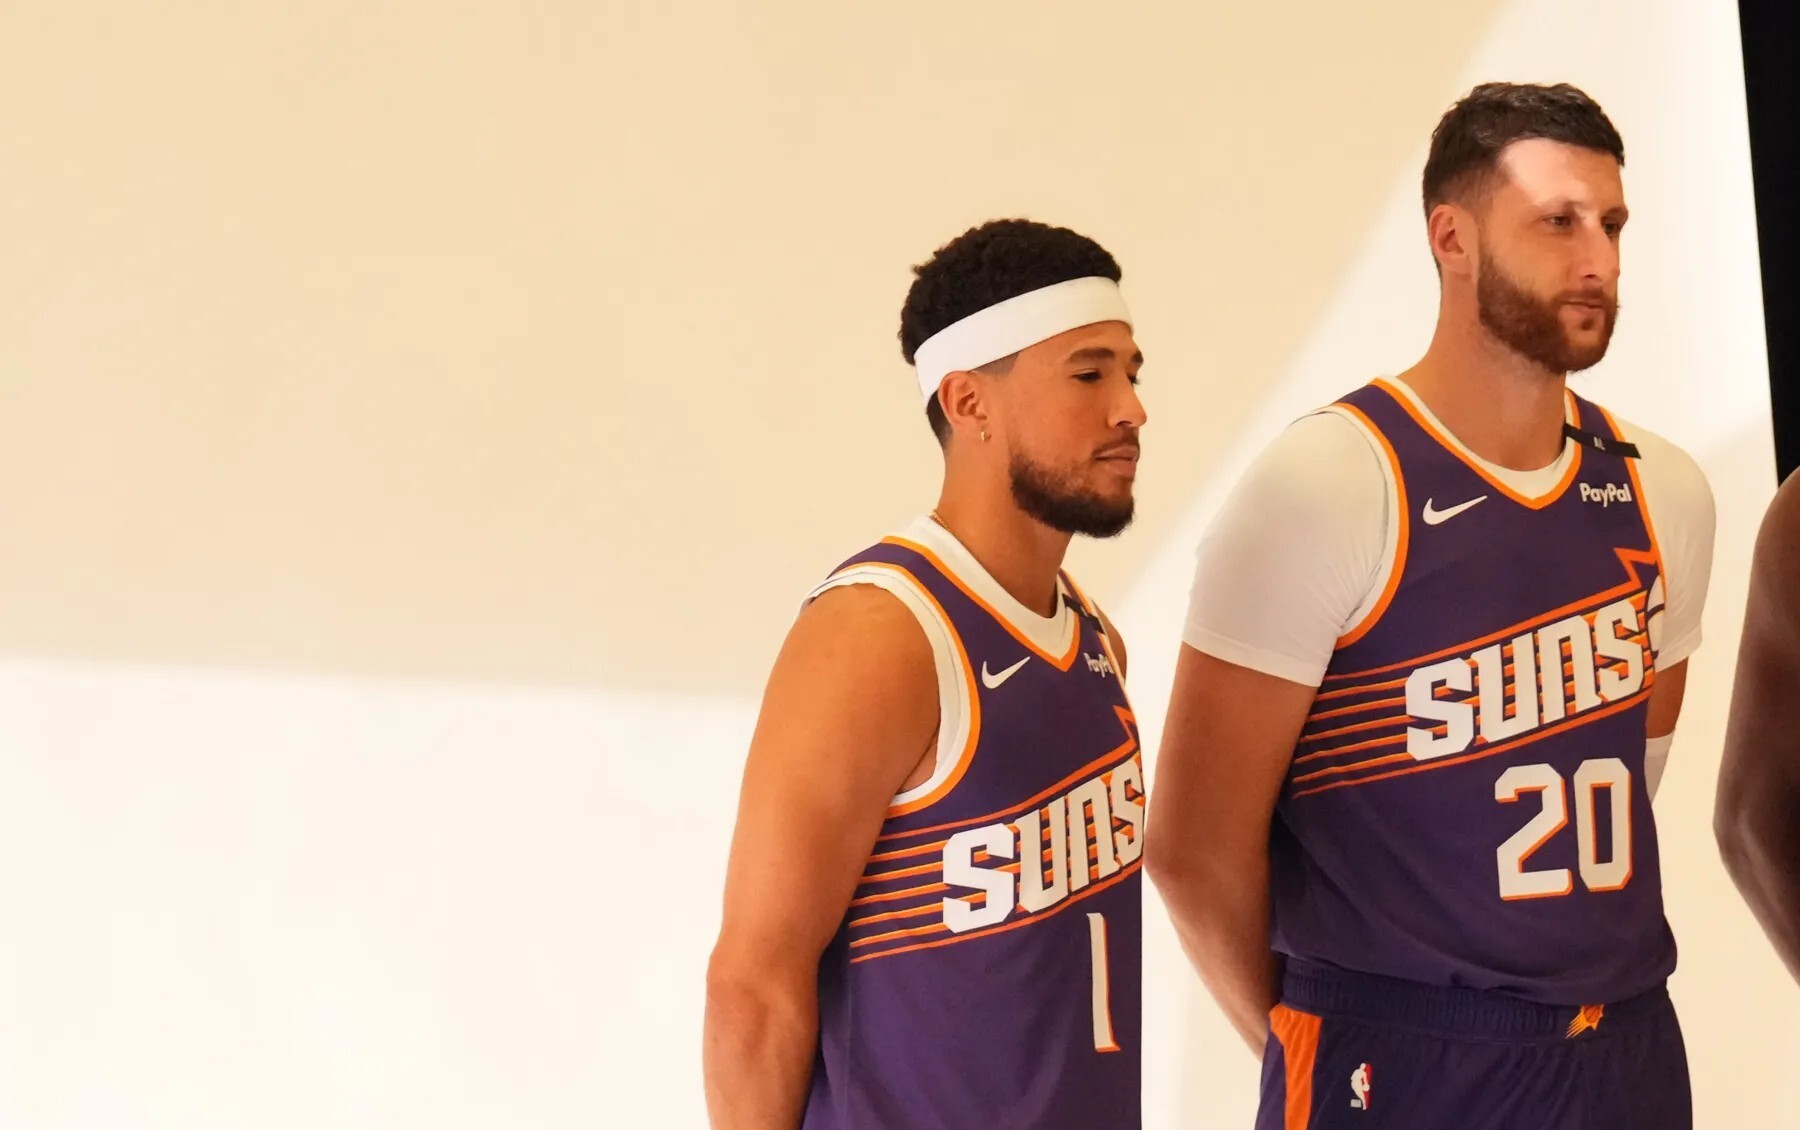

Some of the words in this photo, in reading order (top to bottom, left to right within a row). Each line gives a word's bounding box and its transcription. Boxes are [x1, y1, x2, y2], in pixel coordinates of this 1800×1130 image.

[1579, 482, 1632, 508] PayPal
[1495, 757, 1633, 901] 20
[1087, 912, 1121, 1053] 1
